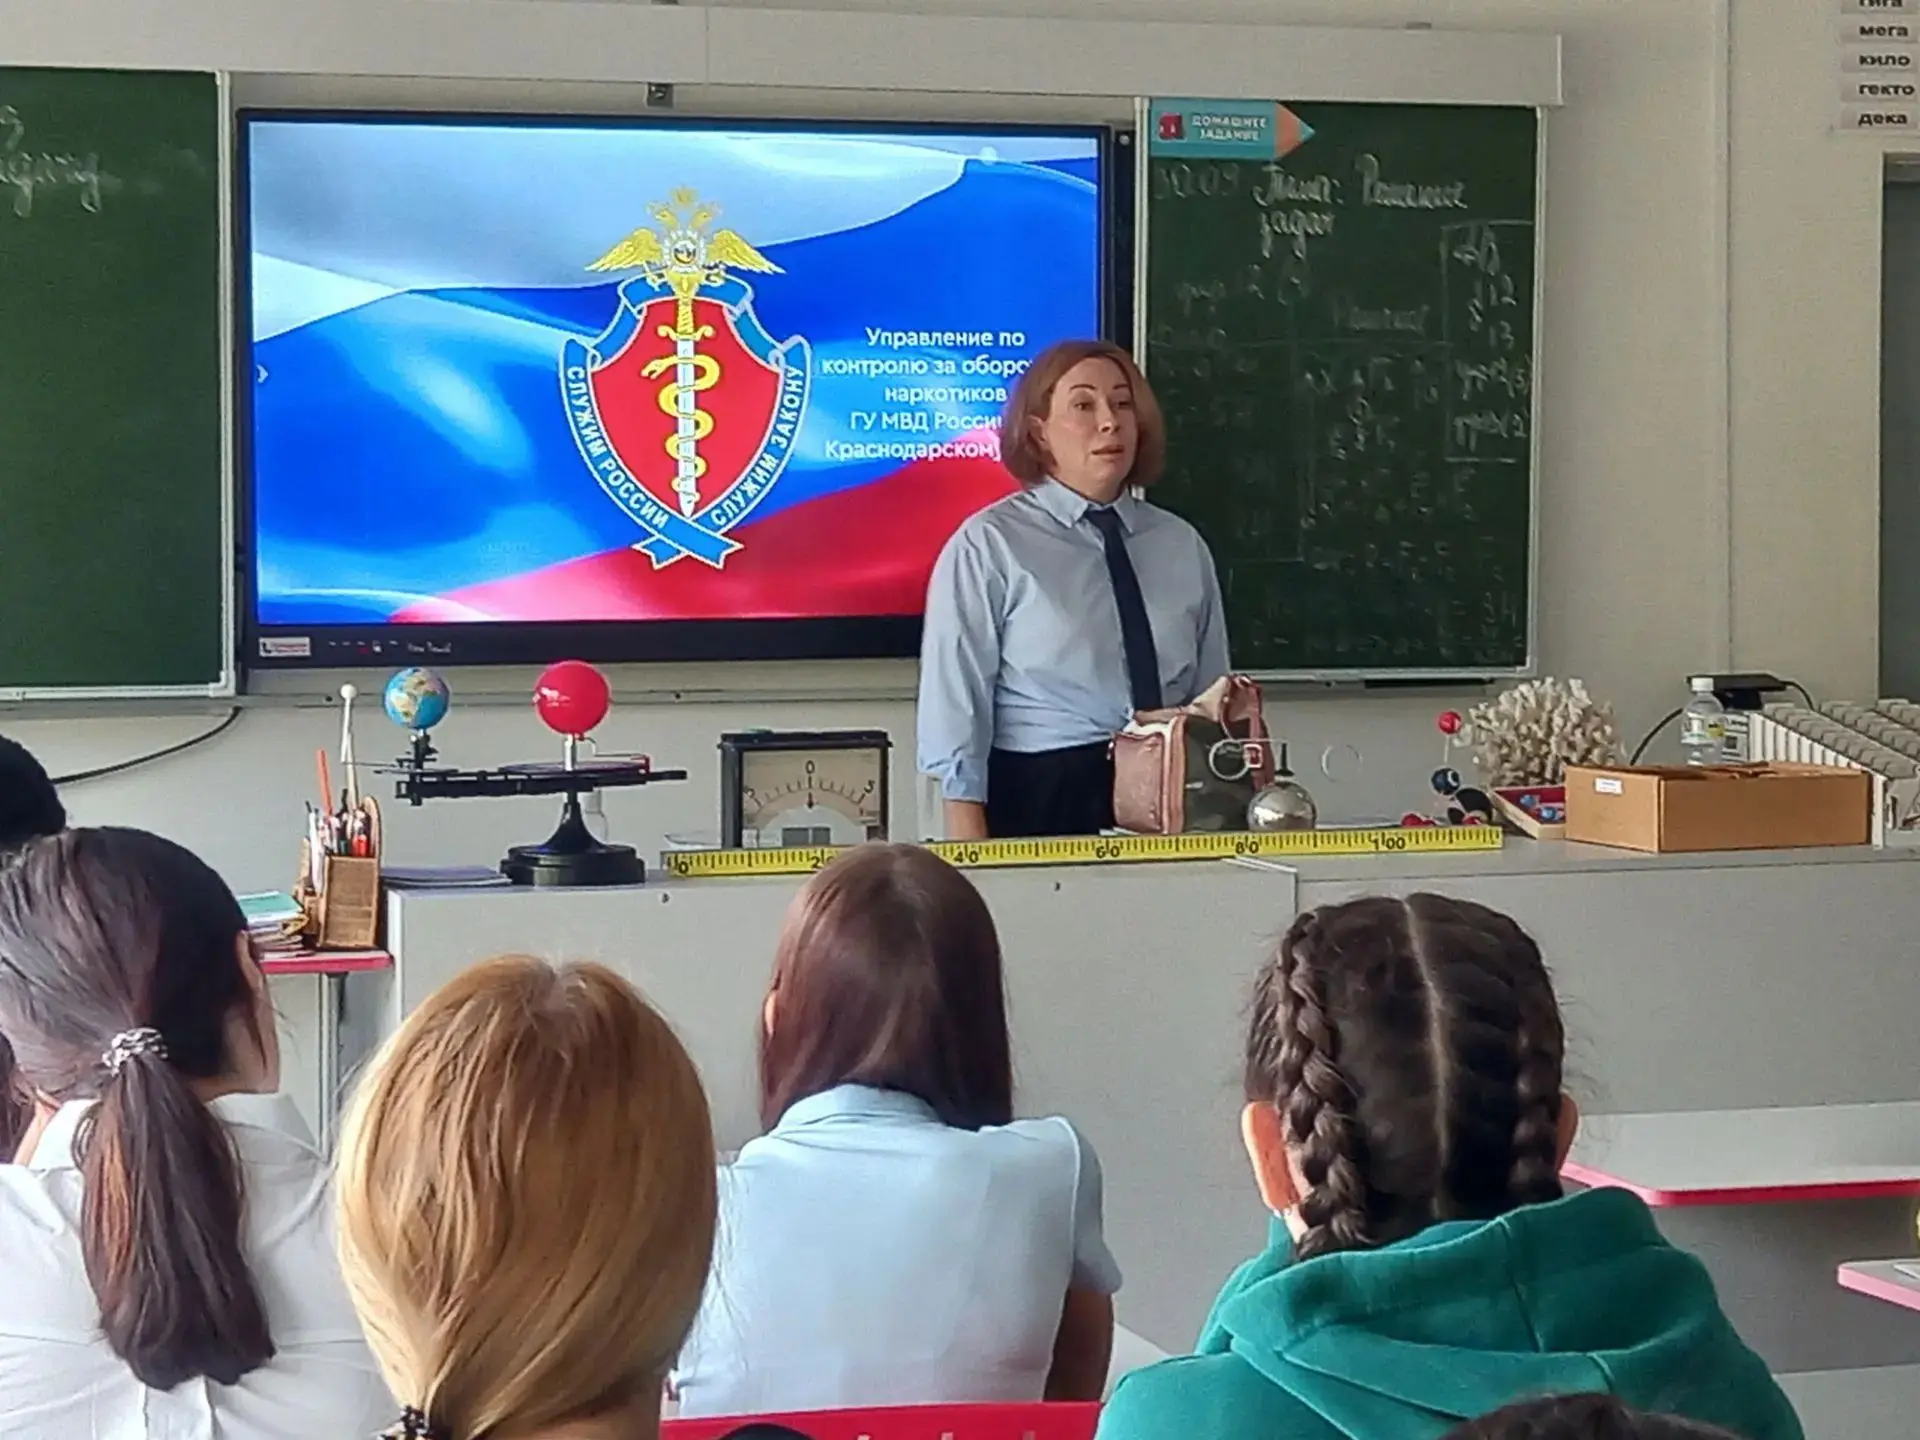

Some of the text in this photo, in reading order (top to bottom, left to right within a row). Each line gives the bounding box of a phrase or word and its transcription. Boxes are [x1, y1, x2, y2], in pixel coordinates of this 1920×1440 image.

[1858, 113, 1908, 127] дека
[865, 326, 1025, 350] Управление по
[822, 354, 1032, 378] контролю за оборо
[885, 386, 1008, 405] наркотиков
[850, 411, 877, 431] ГУ
[881, 411, 929, 433] МВД
[567, 366, 669, 529] СЛУЖИМ РОССИИ
[711, 367, 804, 526] СЛУЖИМ ЗАКОНУ
[805, 760, 815, 774] 0
[1235, 841, 1260, 855] 80
[1372, 837, 1406, 850] 100
[954, 850, 979, 863] 40
[1096, 845, 1121, 859] 60
